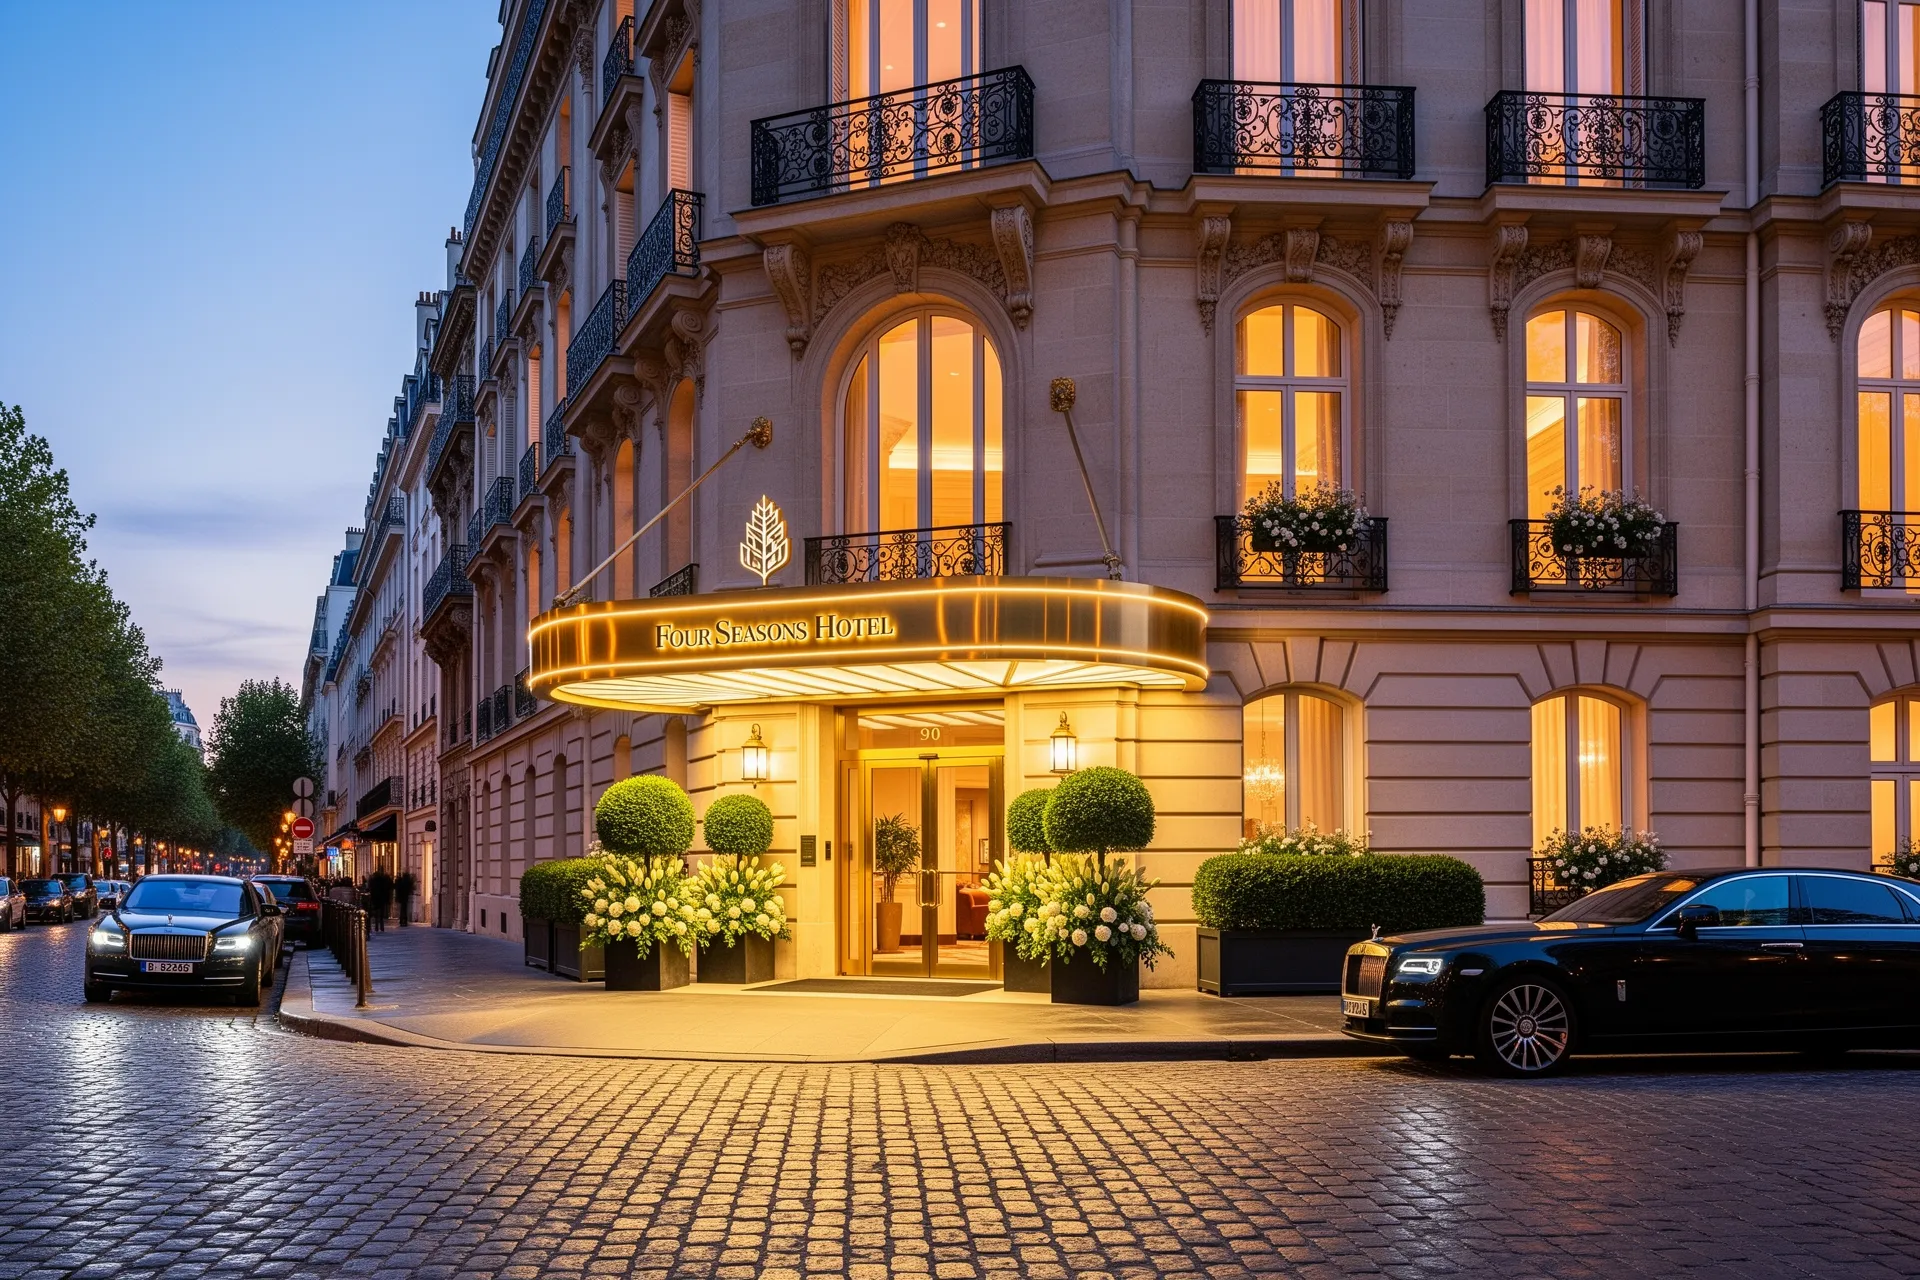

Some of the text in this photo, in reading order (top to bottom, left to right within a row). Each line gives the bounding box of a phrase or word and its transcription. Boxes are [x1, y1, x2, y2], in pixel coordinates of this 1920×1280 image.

[655, 614, 894, 648] FOUR SEASONS HOTEL
[920, 727, 940, 741] 90
